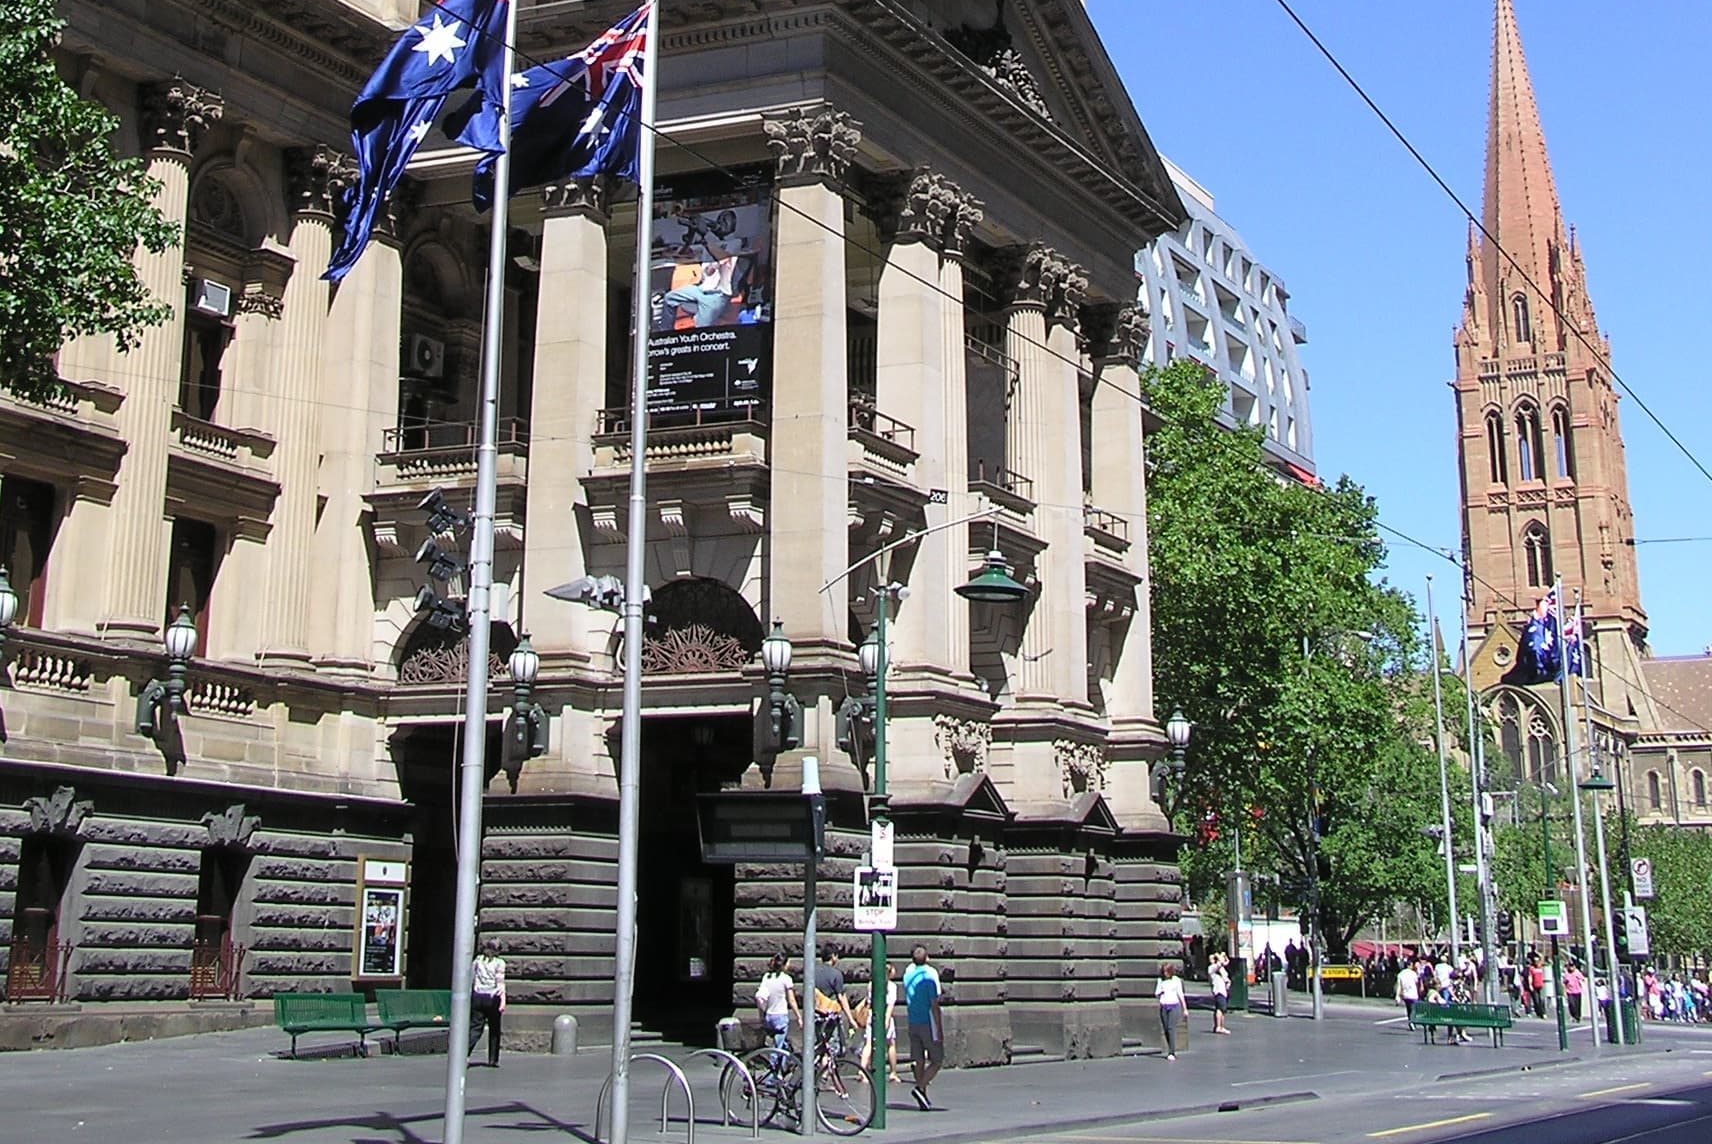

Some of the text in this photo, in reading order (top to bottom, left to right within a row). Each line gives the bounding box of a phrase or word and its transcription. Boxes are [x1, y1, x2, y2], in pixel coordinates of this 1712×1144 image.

[647, 335, 679, 346] Australian
[679, 334, 699, 343] Youth
[692, 344, 700, 352] in
